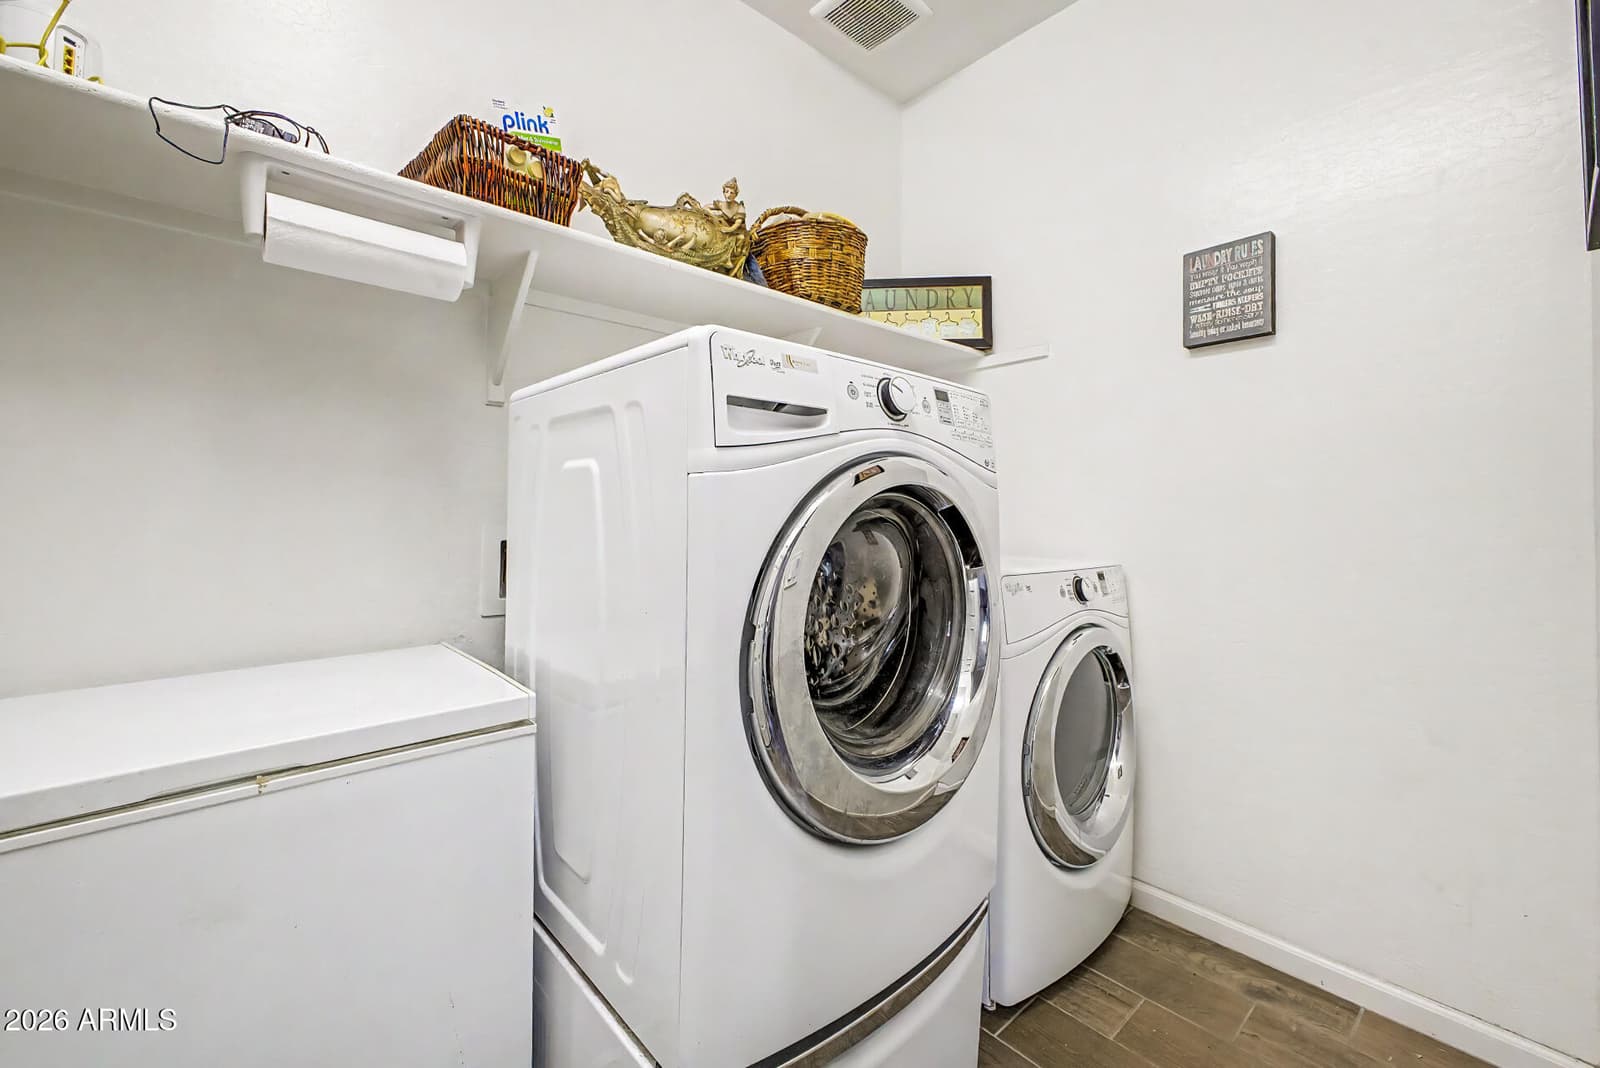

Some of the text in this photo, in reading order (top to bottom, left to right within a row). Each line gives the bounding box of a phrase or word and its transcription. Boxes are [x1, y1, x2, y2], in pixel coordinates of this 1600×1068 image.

[502, 111, 549, 134] plink
[1189, 240, 1264, 273] LAUNDRY RULES
[864, 287, 974, 311] AUNDRY
